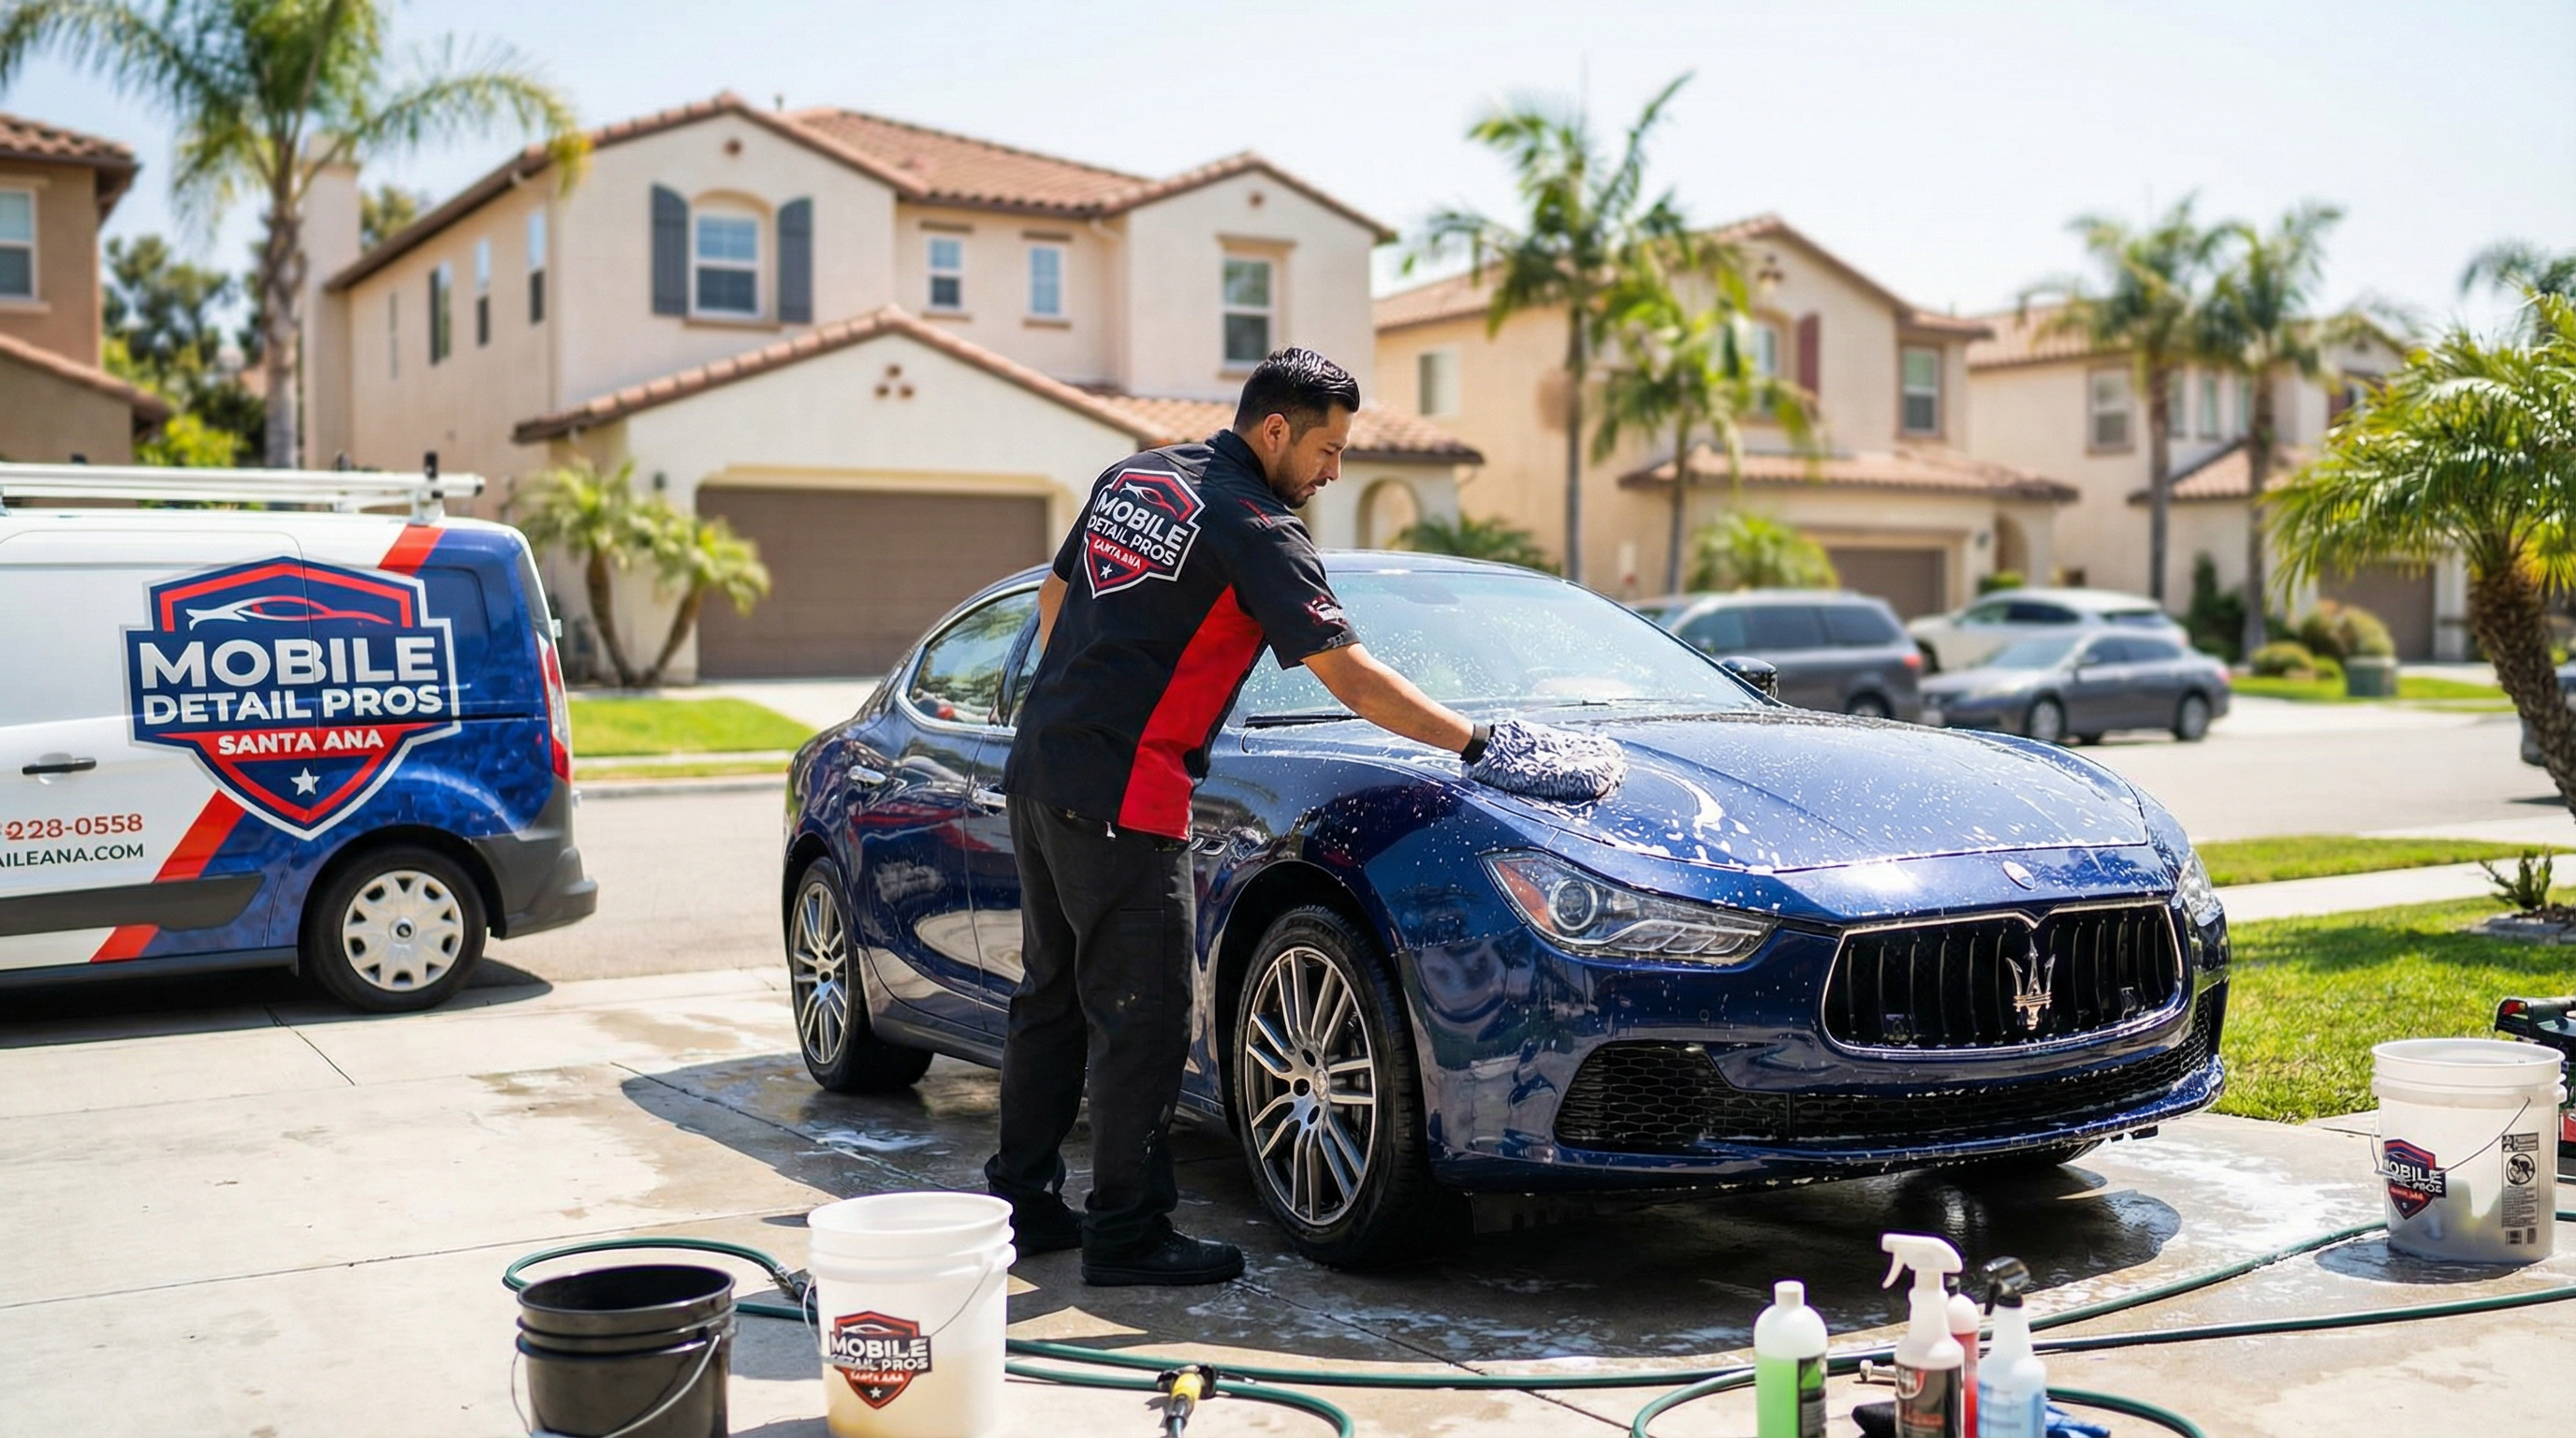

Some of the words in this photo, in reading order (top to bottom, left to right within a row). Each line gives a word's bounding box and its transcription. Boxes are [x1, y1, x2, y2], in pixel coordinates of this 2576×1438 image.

[1095, 492, 1189, 551] MOBILE
[1087, 515, 1128, 544] DETAIL
[1129, 534, 1177, 566] PROS
[139, 637, 438, 689] MOBILE
[143, 690, 312, 725] DETAIL
[323, 684, 443, 718] PROS
[218, 730, 315, 756] SANTA
[323, 728, 385, 751] ANA
[0, 814, 143, 841] 228-0558
[2384, 1159, 2443, 1185] OBILE
[830, 1334, 929, 1358] MOBILE
[882, 1357, 929, 1372] PROS
